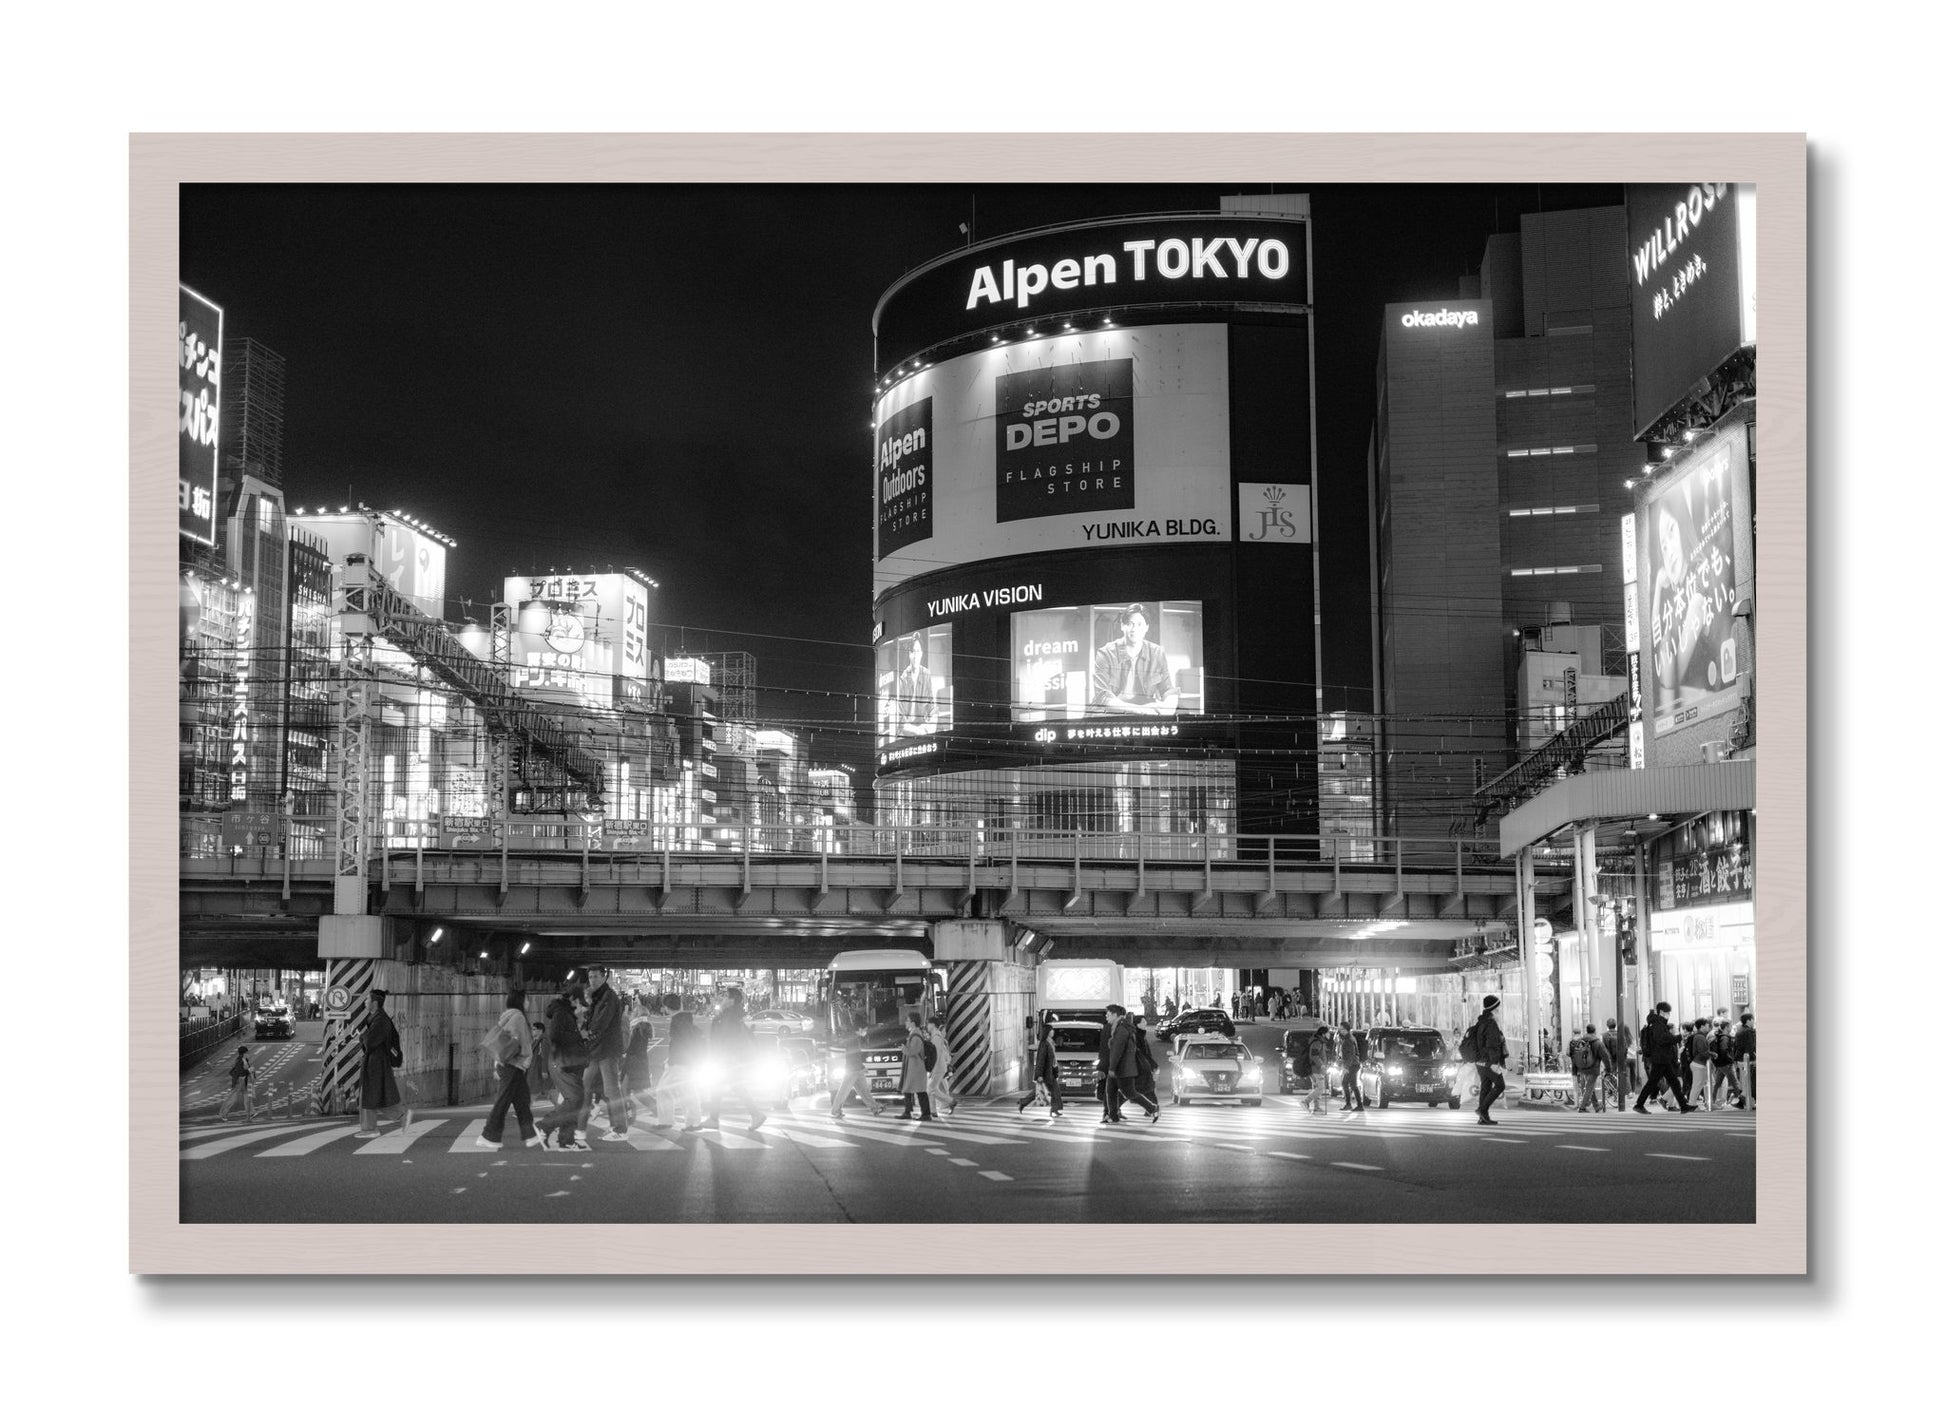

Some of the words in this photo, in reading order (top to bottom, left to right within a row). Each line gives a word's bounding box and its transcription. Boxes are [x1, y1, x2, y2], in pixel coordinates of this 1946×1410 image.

[966, 253, 1116, 310] Alpen
[1123, 238, 1289, 279] TOKYO
[1401, 308, 1478, 328] okadaya
[1023, 393, 1101, 418] SPORTS
[179, 388, 217, 448] スパス
[1006, 411, 1120, 451] DEPO
[880, 427, 926, 472] Alpen
[1006, 459, 1121, 483] FLAGSHIP
[883, 464, 925, 504] Outdoors
[1047, 477, 1121, 494] STORE
[880, 492, 926, 525] FLAGSHIP
[892, 508, 926, 531] STORE
[1082, 520, 1161, 541] YUNIKA
[1166, 519, 1221, 536] BLDG.
[298, 585, 327, 605] SHISHA
[529, 578, 598, 600] プロミス
[1652, 546, 1731, 648] 自分本位でも、
[927, 593, 981, 618] YUNIKA
[983, 584, 1043, 607] VISION
[1024, 640, 1079, 656] dream
[1035, 728, 1056, 743] dip
[1067, 725, 1178, 739] 夢を叶える仕事に出会おう
[444, 817, 489, 828] 新宿駅東口
[605, 820, 648, 830] 新宿駅東口
